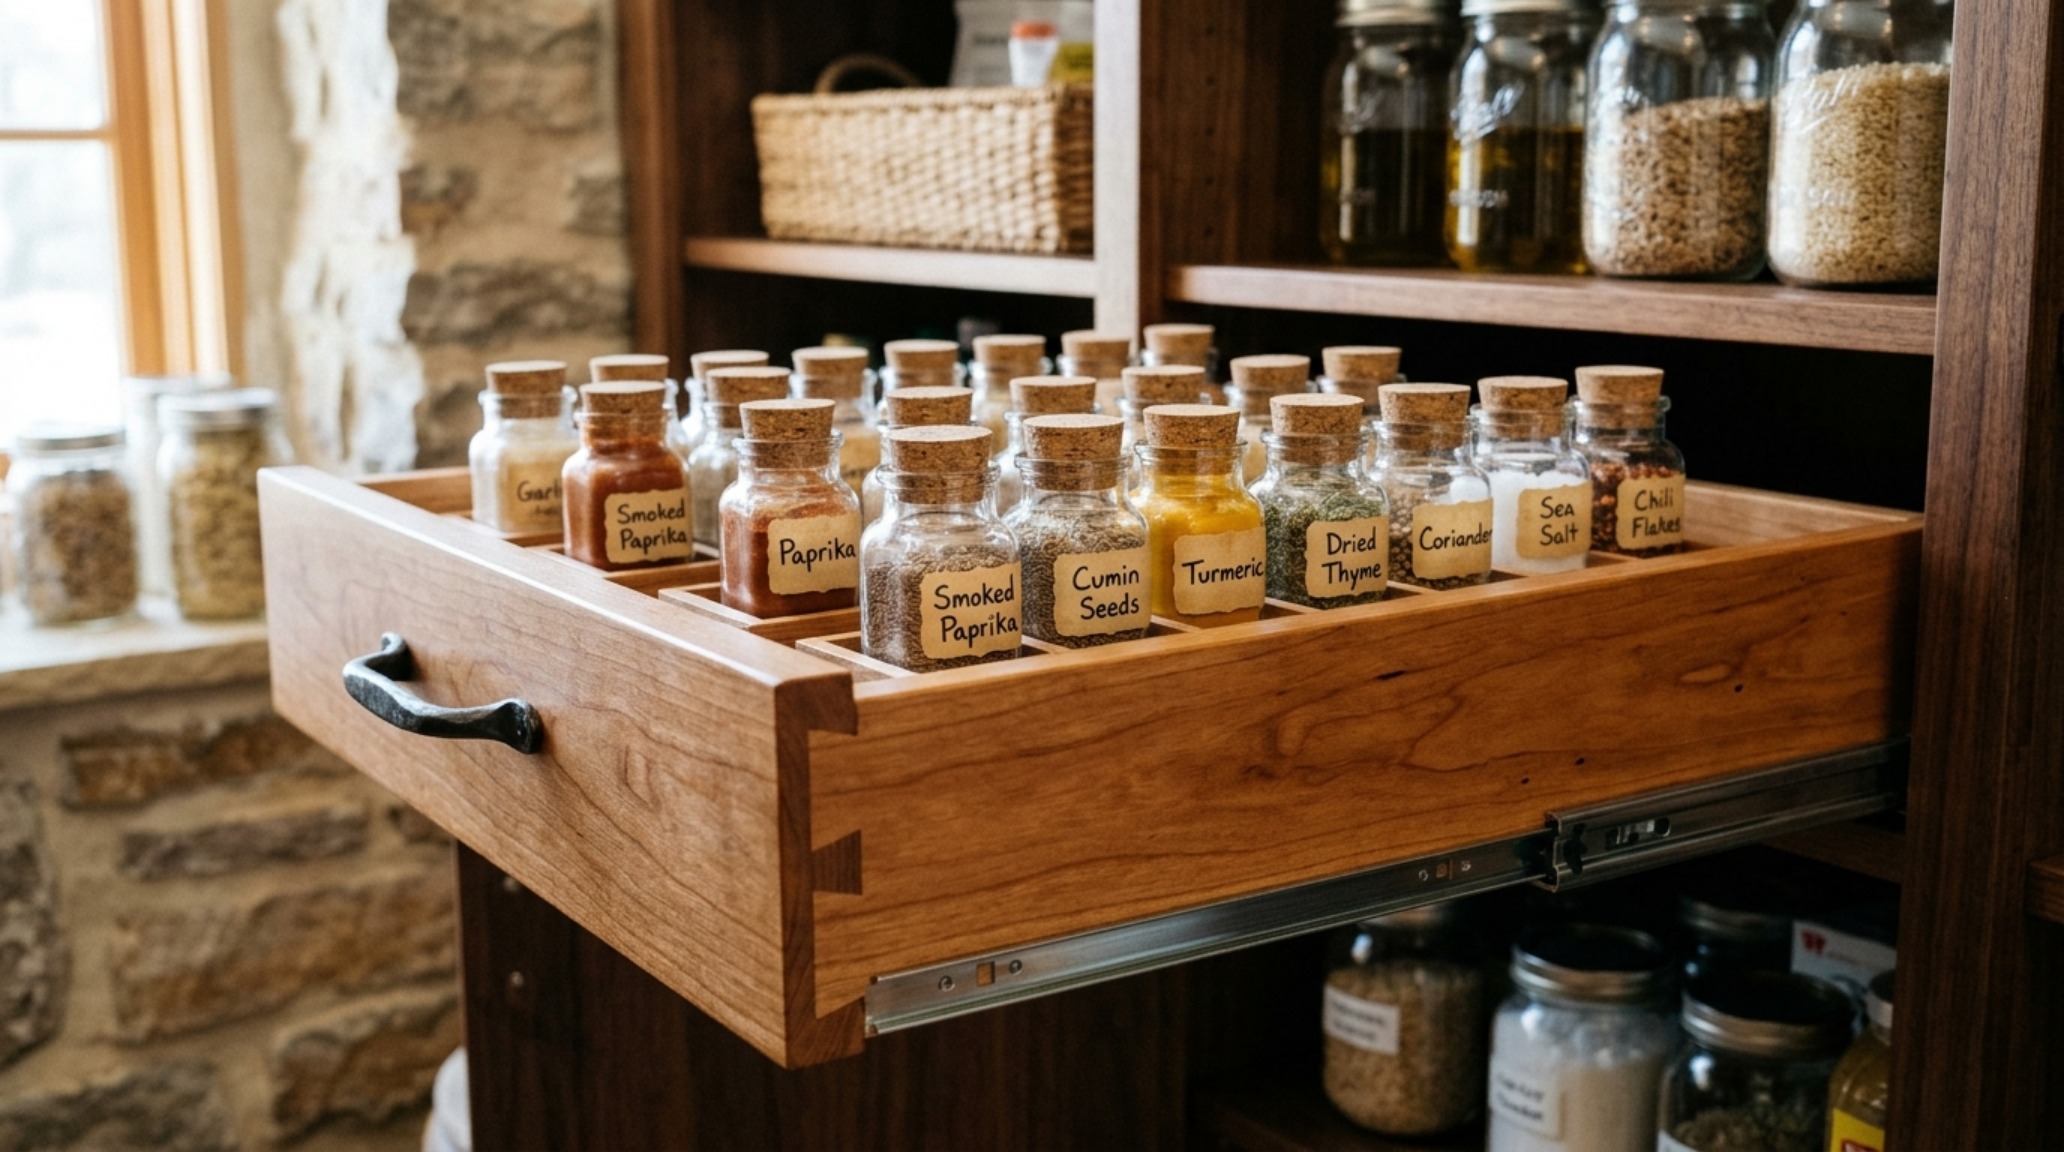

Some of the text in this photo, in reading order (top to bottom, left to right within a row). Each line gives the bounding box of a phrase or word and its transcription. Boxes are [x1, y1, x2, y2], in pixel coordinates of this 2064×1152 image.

[616, 496, 685, 525] Smoked
[1634, 487, 1674, 511] Chili
[619, 526, 688, 555] Paprika
[1326, 527, 1377, 556] Dried
[1540, 523, 1579, 546] Salt
[1632, 516, 1681, 538] Flakes
[779, 537, 857, 572] Paprika
[1072, 564, 1140, 591] Cumin
[1181, 556, 1264, 585] Turmeric
[1321, 560, 1382, 591] Thyme
[933, 573, 1015, 610] Smoked
[1079, 597, 1140, 621] Seeds
[940, 612, 1019, 648] Paprika
